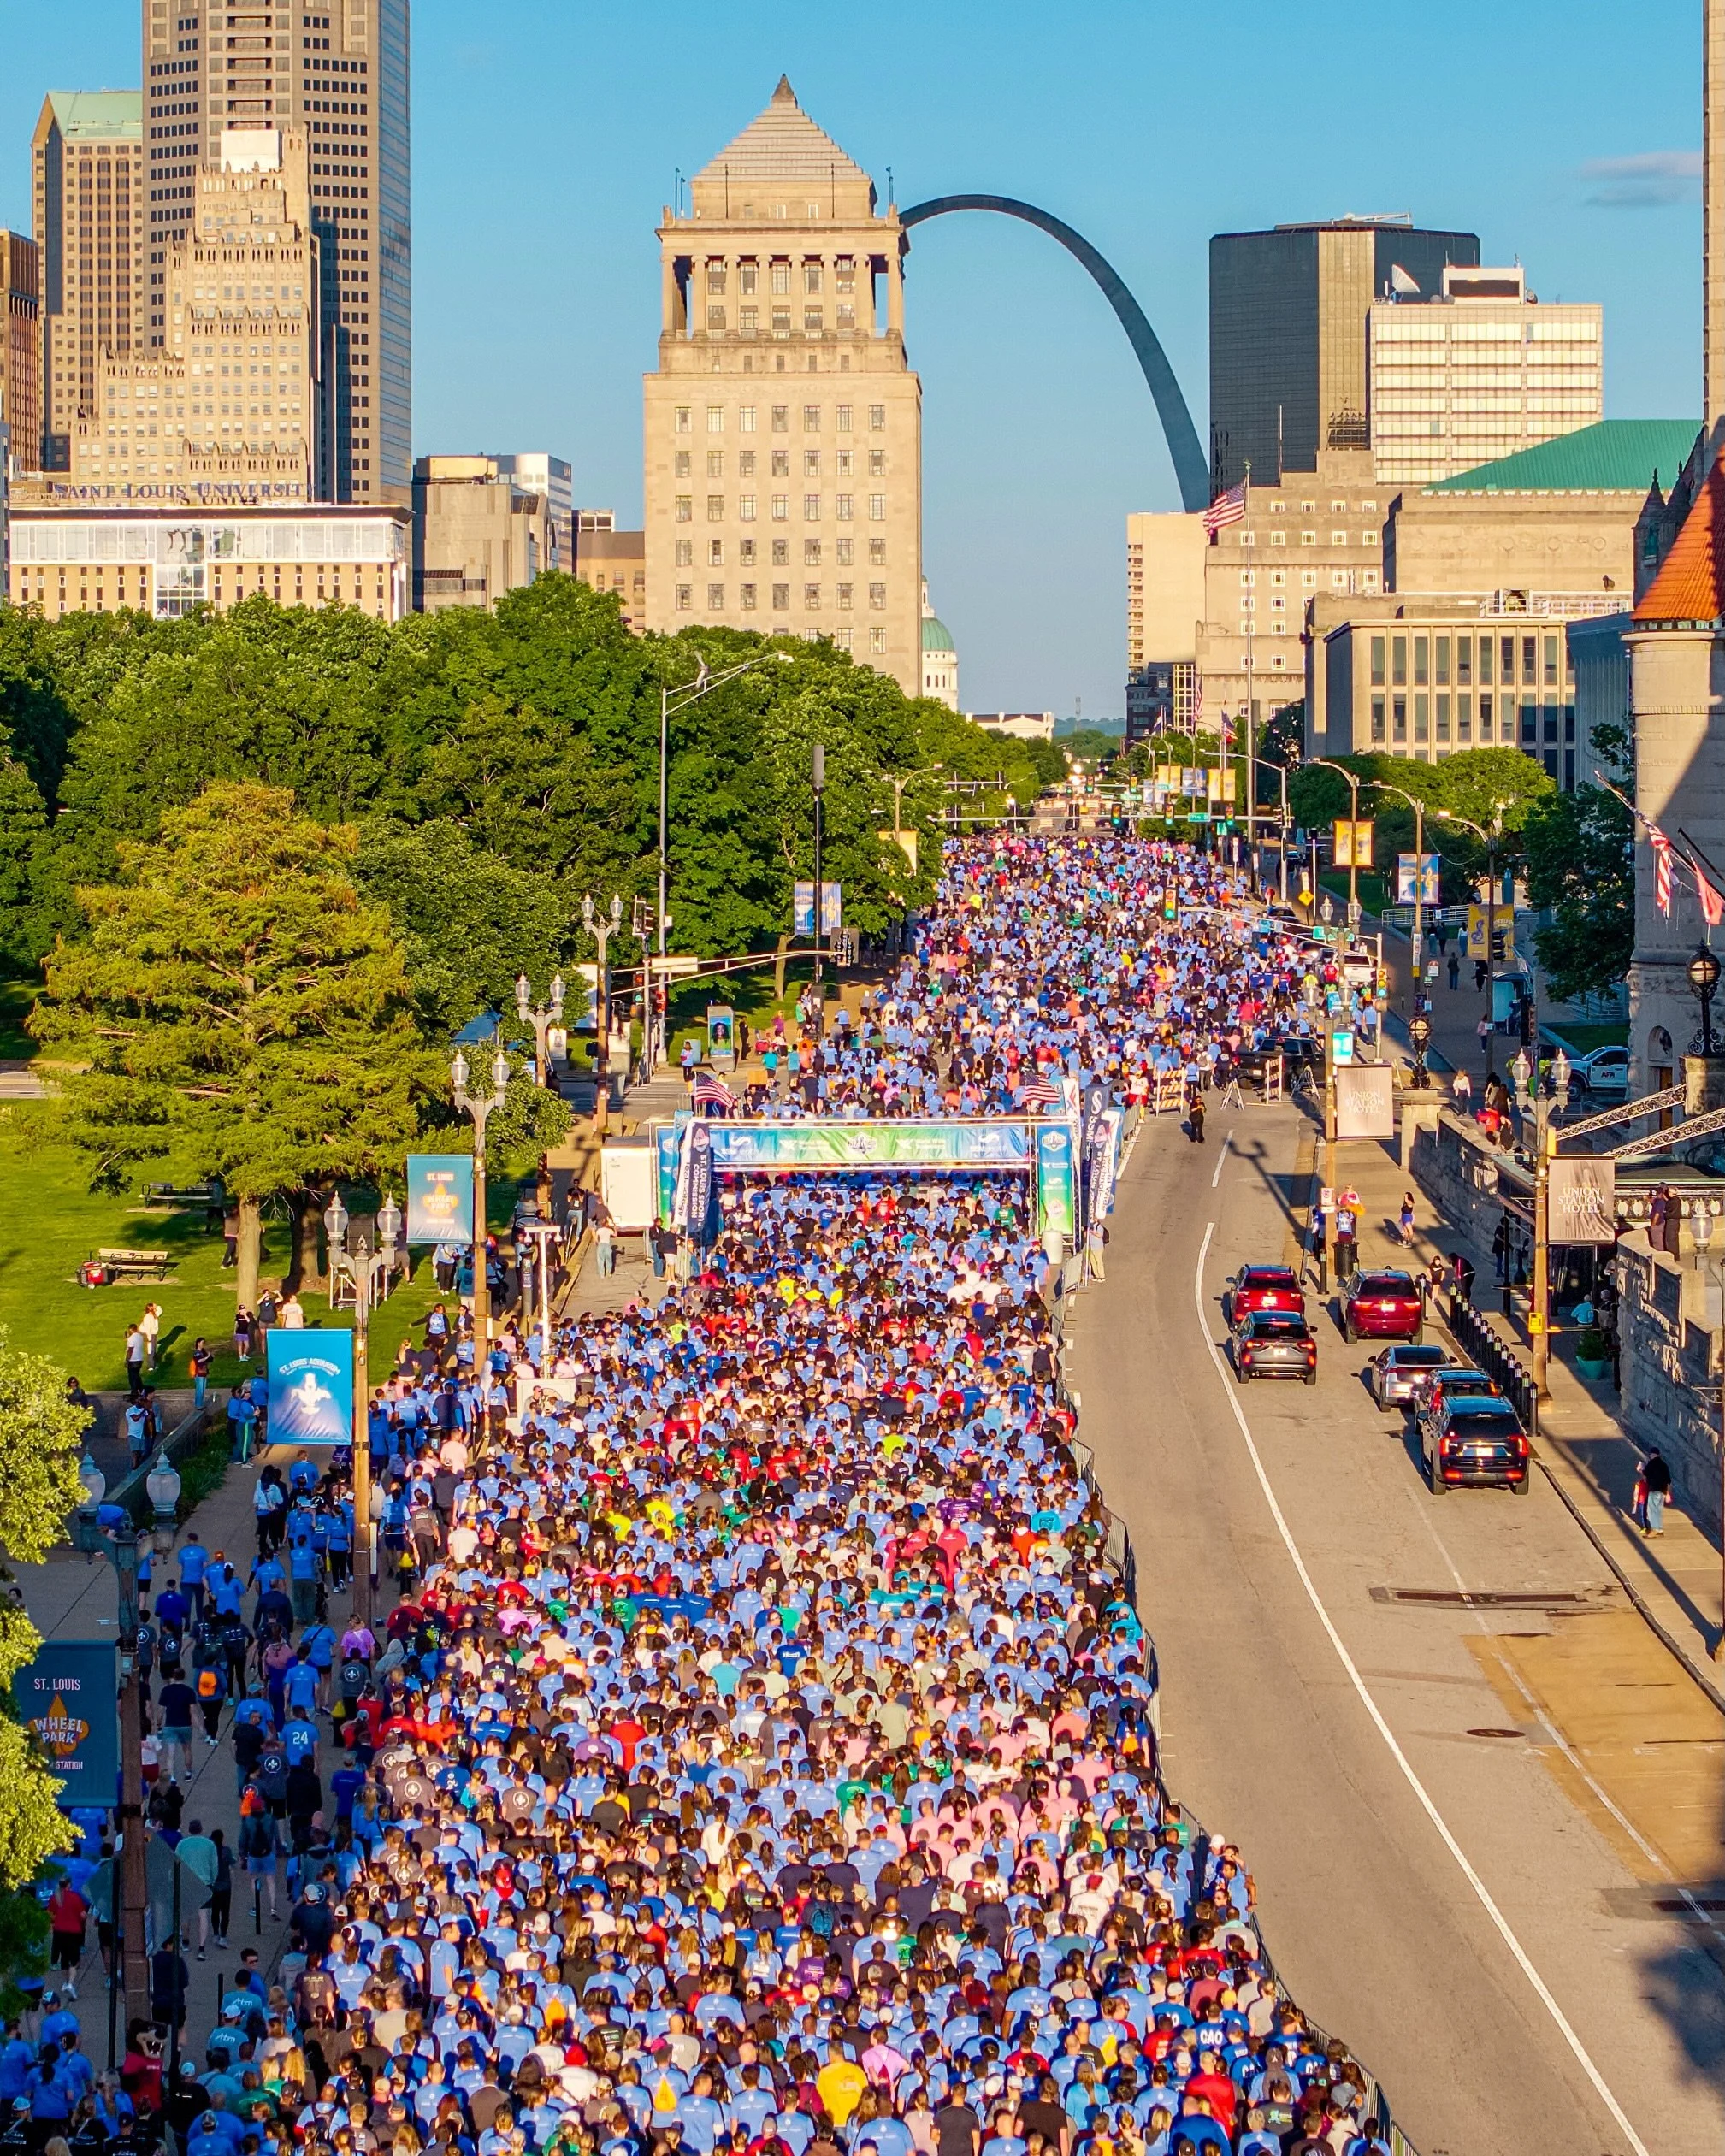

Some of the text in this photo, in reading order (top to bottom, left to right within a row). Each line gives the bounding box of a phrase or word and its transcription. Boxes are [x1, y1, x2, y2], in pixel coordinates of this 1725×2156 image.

[126, 484, 186, 498] LOUIS
[1349, 1090, 1380, 1099] UNION
[699, 1168, 707, 1193] LOUIS
[691, 1163, 700, 1218] COMMISSION
[1563, 1187, 1600, 1196] UNION
[1558, 1196, 1604, 1204] STATION
[1563, 1204, 1599, 1213] HOTEL
[289, 1358, 307, 1368] LOUIS
[34, 1679, 80, 1690] ST. LOUIS
[34, 1717, 83, 1733] WHEEL
[42, 1732, 75, 1743] PARK
[292, 1731, 308, 1744] 24
[56, 1761, 83, 1769] STATION
